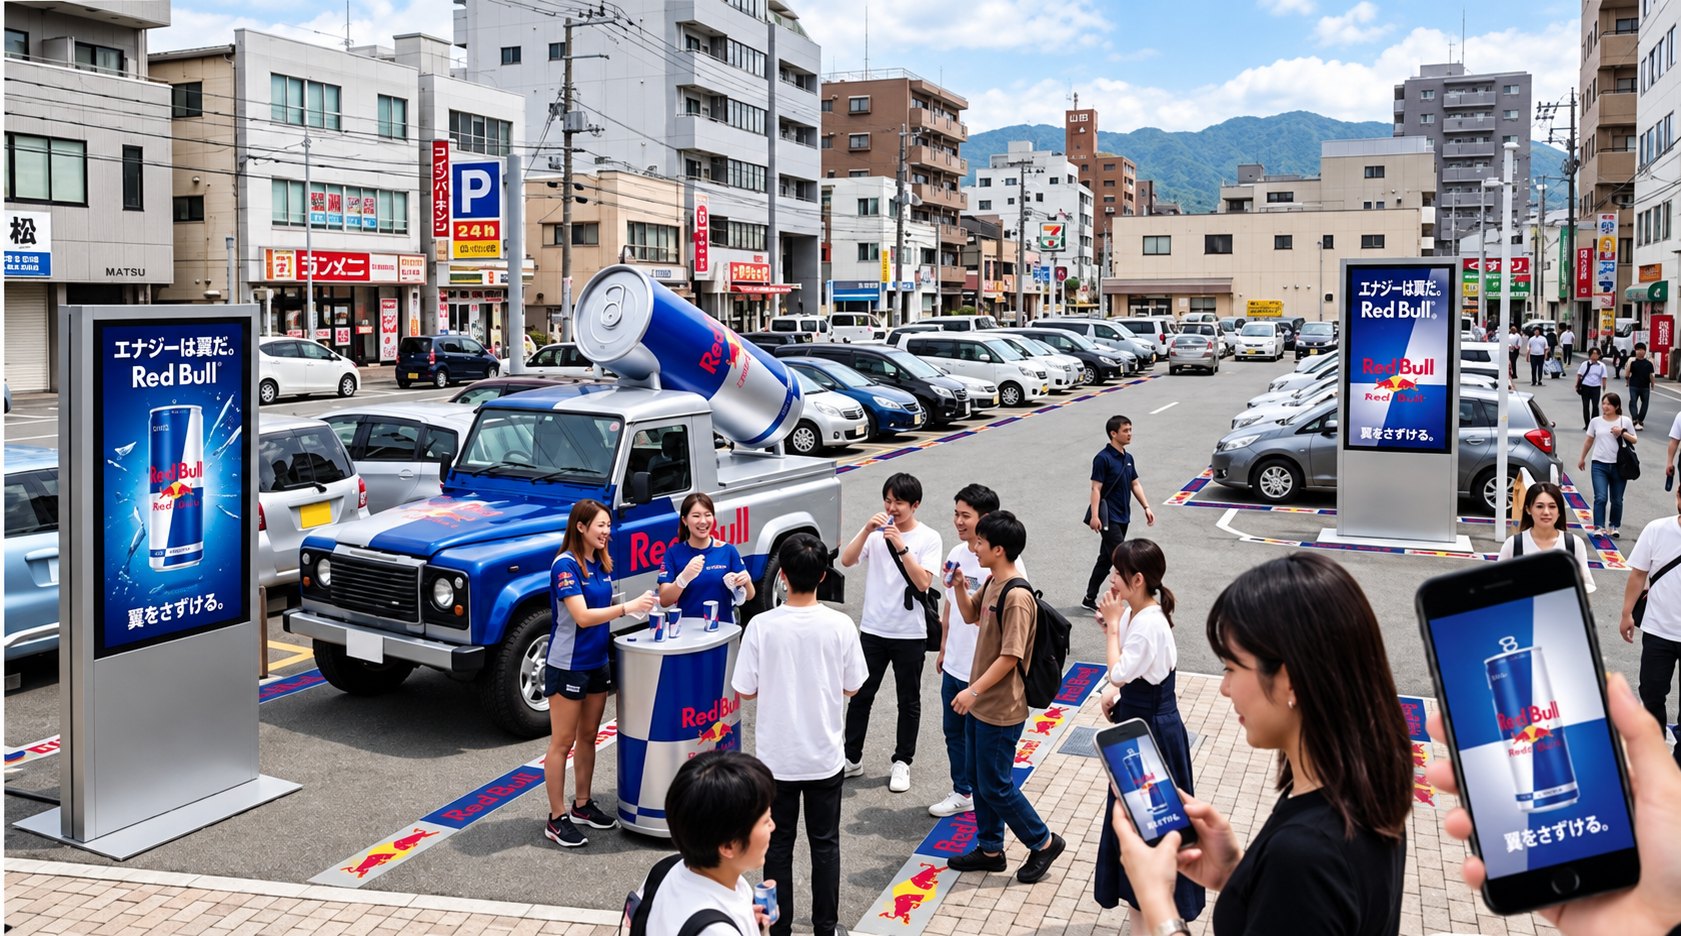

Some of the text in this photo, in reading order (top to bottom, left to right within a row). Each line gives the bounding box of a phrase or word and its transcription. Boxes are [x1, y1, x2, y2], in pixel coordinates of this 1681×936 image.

[461, 169, 492, 213] P
[10, 216, 37, 245] 松
[106, 267, 146, 277] MATSU
[1361, 300, 1431, 318] Red Bull
[114, 336, 235, 359] エナジーは翼だ。
[132, 361, 217, 388] Red Bull
[1363, 358, 1435, 375] Red Bull
[1361, 427, 1434, 441] 翼をさずける。
[150, 461, 203, 483] Red Bull
[631, 531, 679, 572] Re
[127, 593, 224, 630] 翼をさずける。
[682, 700, 719, 729] Red
[1528, 700, 1560, 723] Bull
[487, 772, 543, 797] Bull
[1503, 815, 1609, 853] 翼をさずける。
